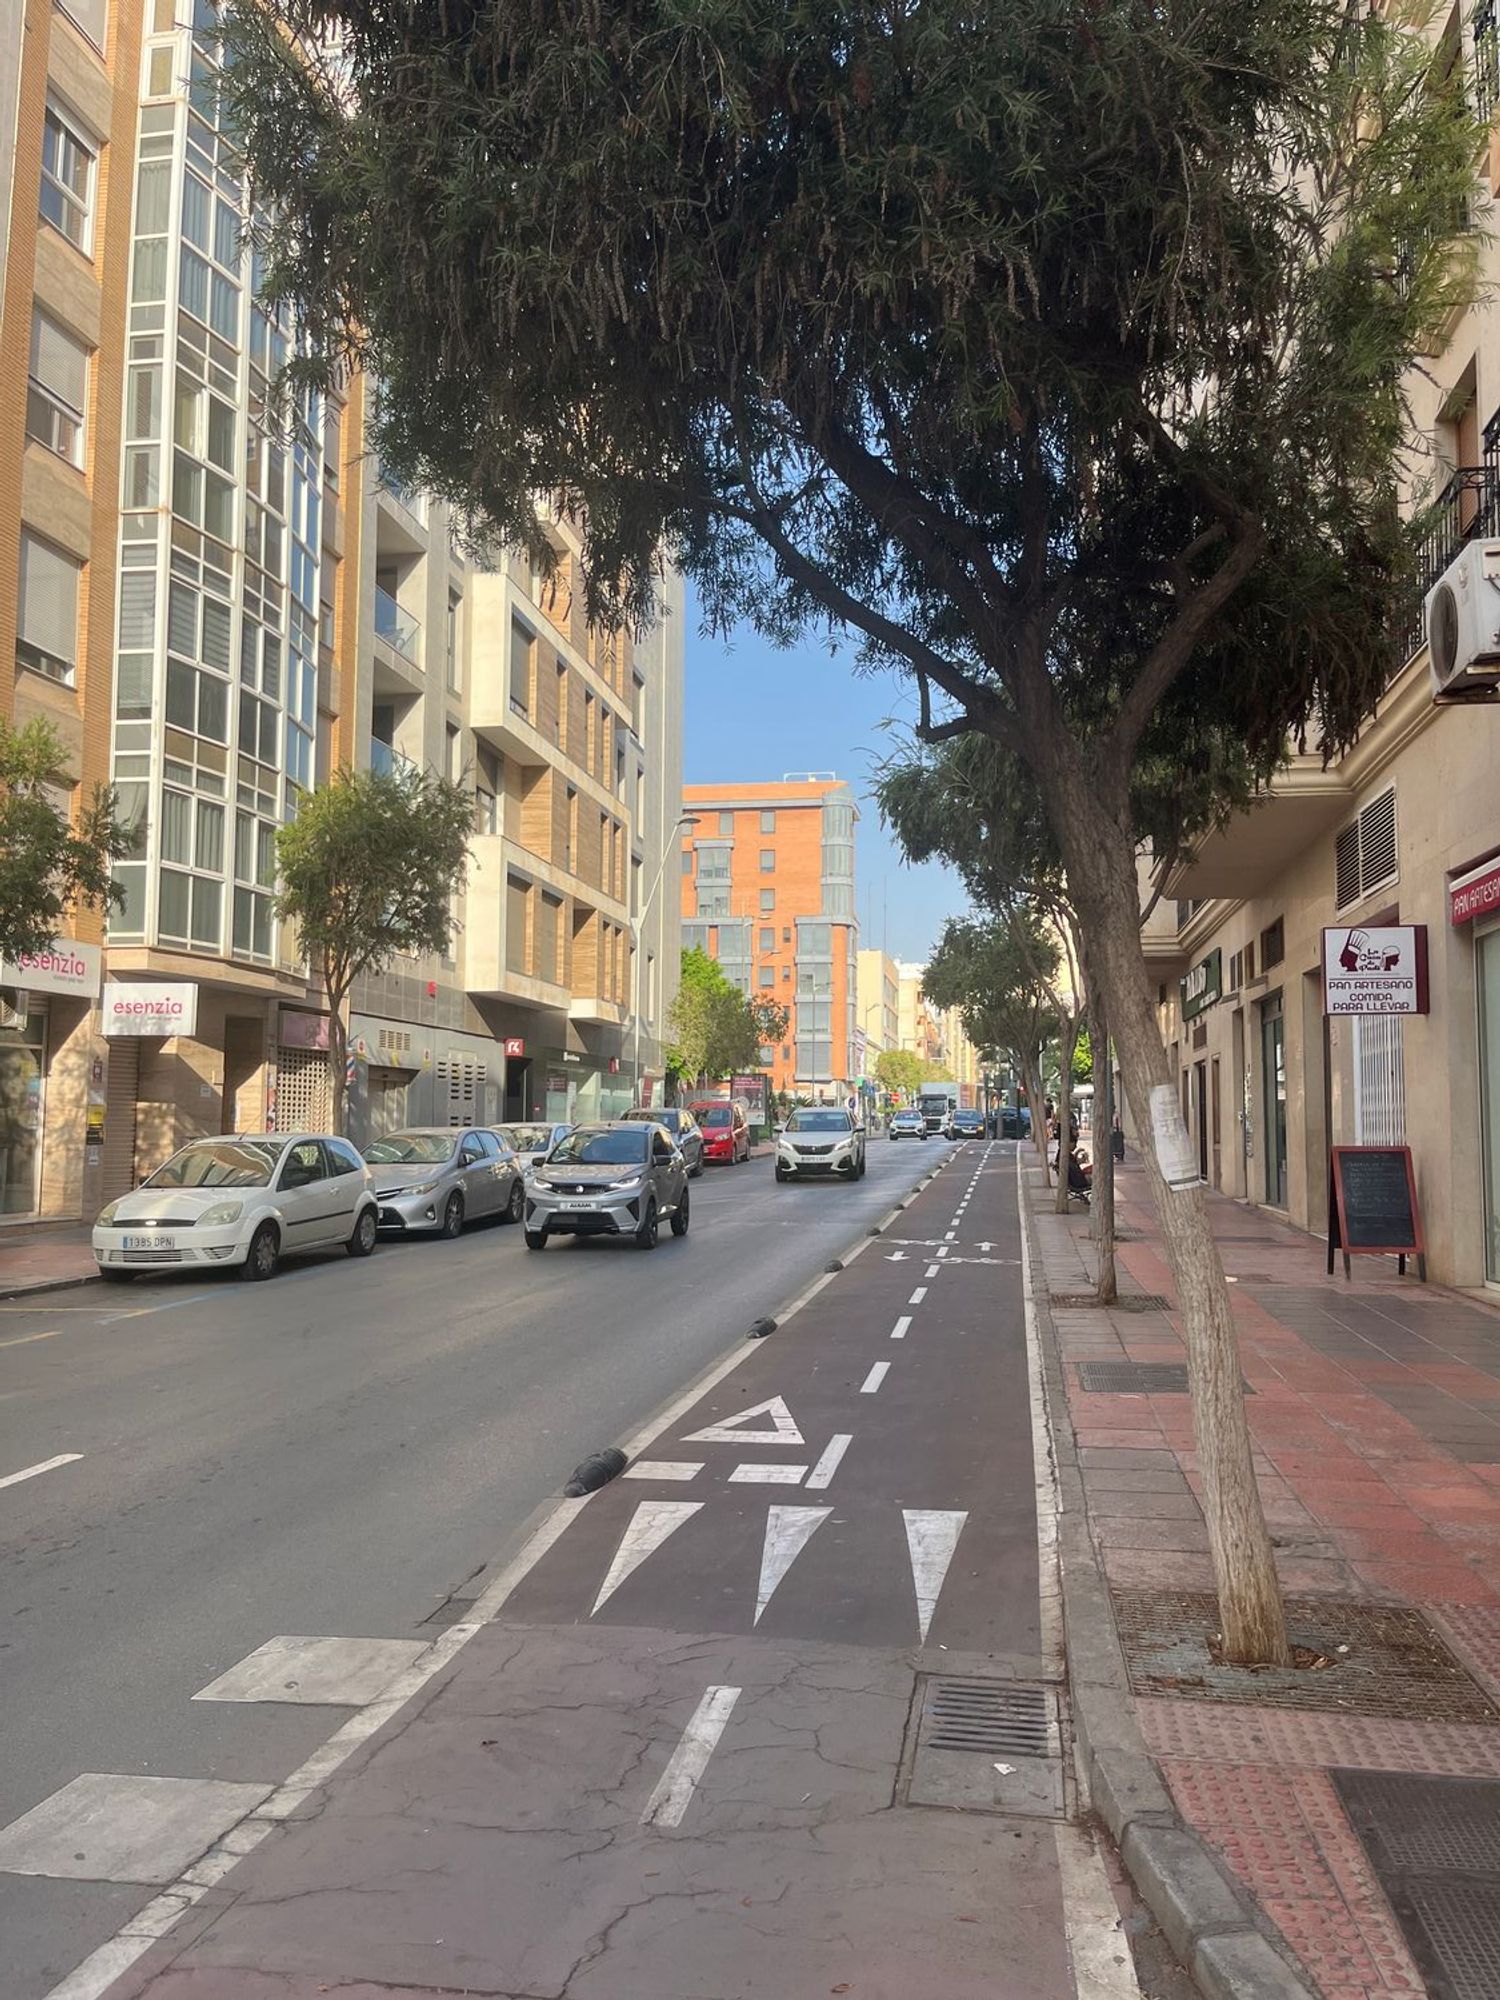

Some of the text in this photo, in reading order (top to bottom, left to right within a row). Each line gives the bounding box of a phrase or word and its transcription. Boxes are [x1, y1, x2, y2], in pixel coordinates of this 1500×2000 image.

[20, 951, 86, 977] esenzia
[1329, 980, 1413, 990] PAN ARTESANO
[1349, 993, 1393, 1002] COMIDA
[113, 996, 183, 1015] esenzia
[1333, 1002, 1410, 1011] PARA LLEVAR
